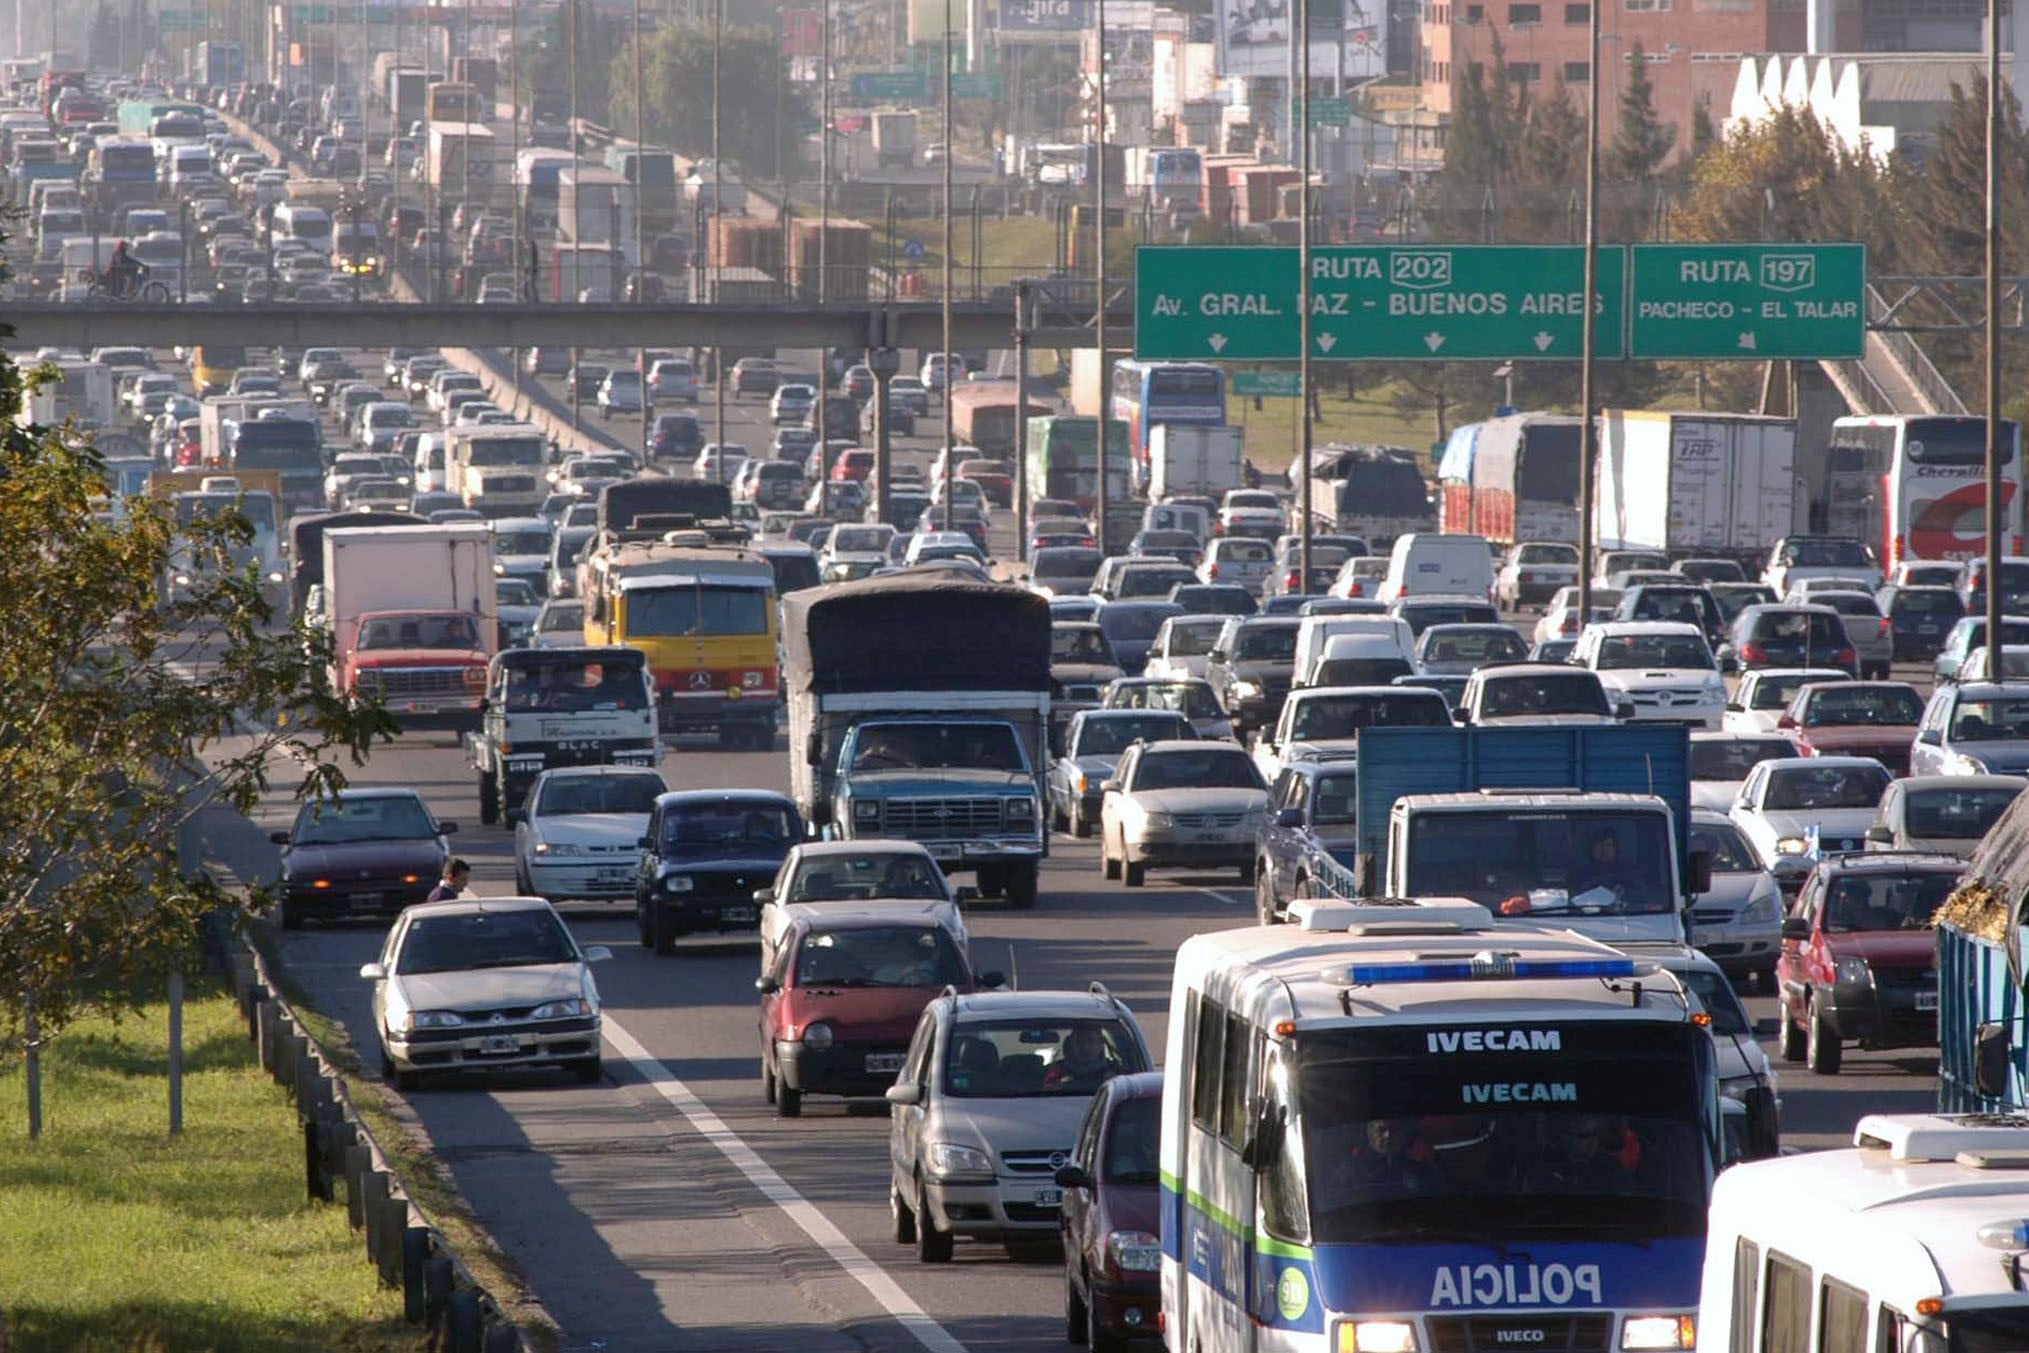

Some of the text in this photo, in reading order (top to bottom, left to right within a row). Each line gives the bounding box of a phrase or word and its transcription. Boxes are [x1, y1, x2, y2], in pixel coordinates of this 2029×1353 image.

[1311, 256, 1448, 280] RUTA 202
[1680, 260, 1811, 282] RUTA 197
[1152, 294, 1188, 316] Av.
[1199, 293, 1281, 316] GRAL.
[1389, 292, 1508, 315] BUENOS
[1638, 302, 1734, 319] PACHECO
[1761, 302, 1787, 318] EL
[1794, 302, 1858, 318] TALAR
[1426, 1030, 1561, 1053] IVECAM
[1461, 1083, 1578, 1103] IVECAM
[1496, 1330, 1545, 1342] IVECO
